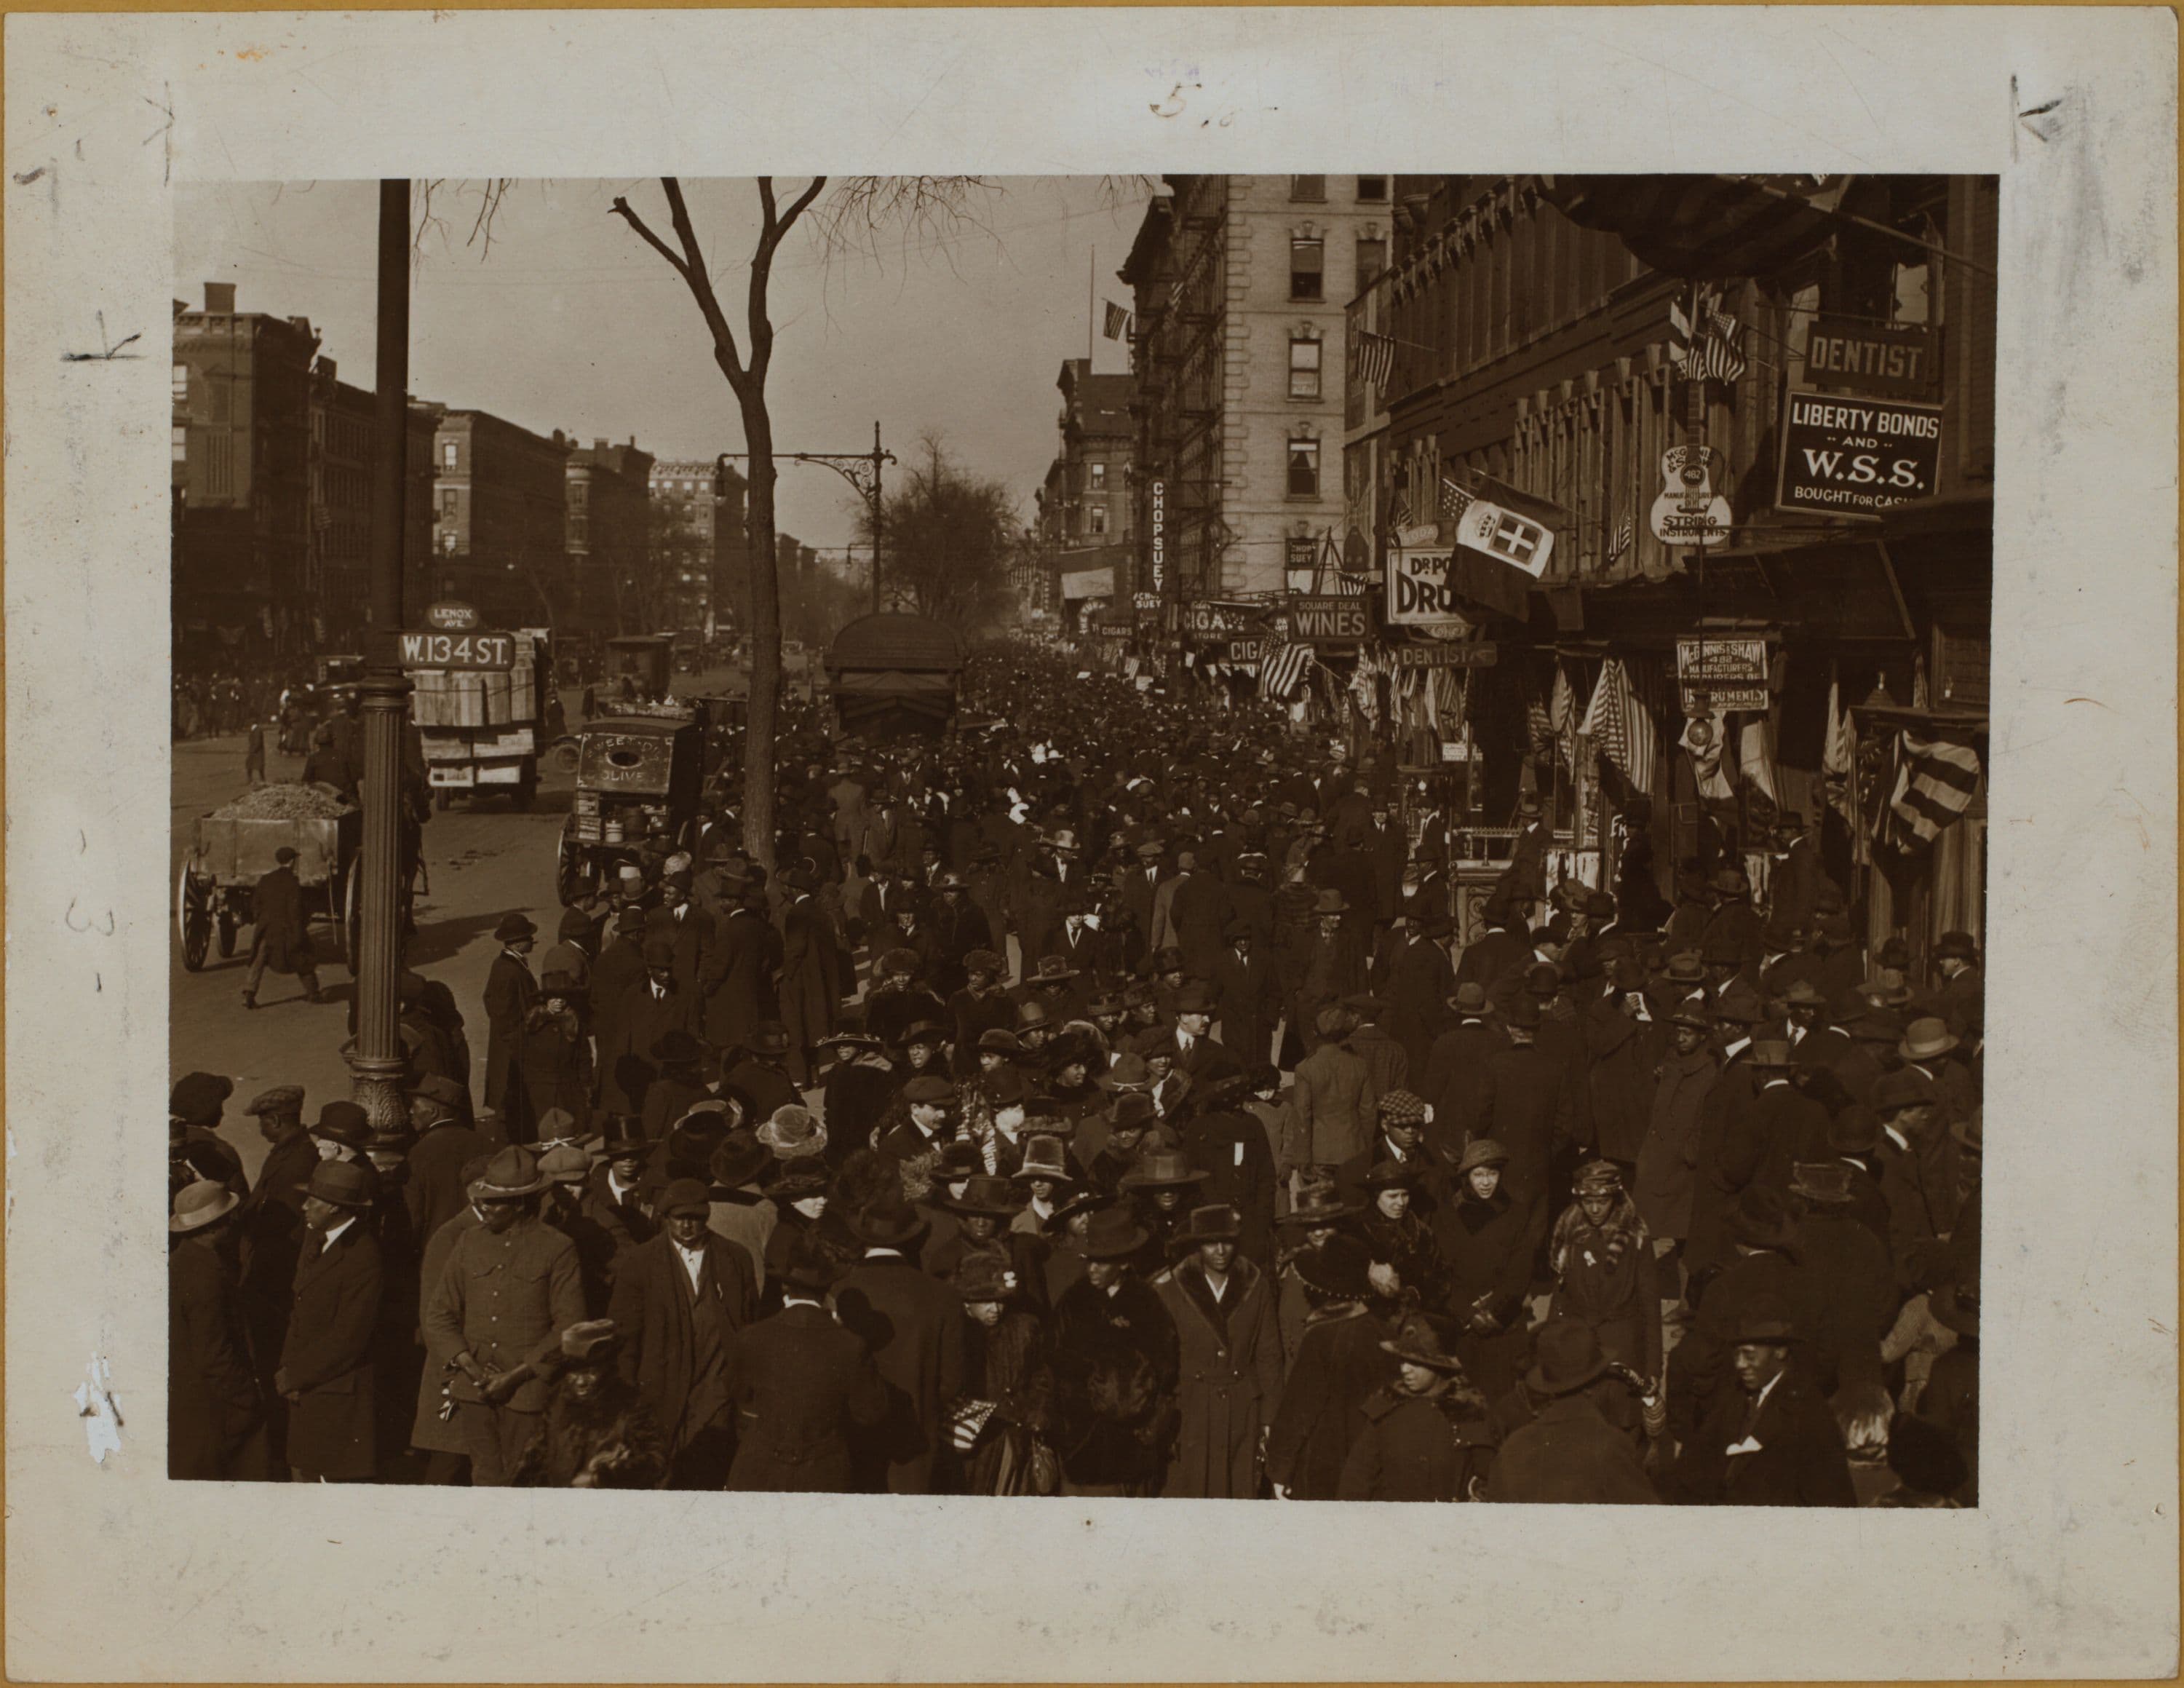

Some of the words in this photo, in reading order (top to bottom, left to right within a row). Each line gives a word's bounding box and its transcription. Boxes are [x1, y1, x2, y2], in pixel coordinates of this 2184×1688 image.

[1810, 336, 1923, 379] DENTIST
[1792, 402, 1875, 432] LIBERTY
[1875, 411, 1939, 439] BONDS
[1841, 436, 1878, 449] AND
[1683, 469, 1701, 480] 482
[1803, 448, 1925, 490] W.S.S.
[1794, 486, 1853, 504] BOUGHT
[1853, 494, 1873, 506] FOR
[1874, 495, 1914, 508] CAS
[1663, 515, 1718, 526] STRING
[1290, 553, 1312, 563] SUEY
[1135, 599, 1162, 609] SUEY
[1298, 601, 1335, 611] SQUARE
[1338, 601, 1362, 611] DEAL
[434, 609, 472, 619] LENOX
[1295, 611, 1366, 636] WINES
[1101, 627, 1133, 637] CIGARS
[1194, 633, 1223, 641] STORE
[476, 638, 508, 665] ST.
[1402, 649, 1469, 665] DENTIST
[1731, 643, 1761, 666] SHAW
[1709, 655, 1733, 663] 482
[1688, 663, 1753, 673] MANUFACTURERS
[1684, 687, 1764, 703] INRUMENTS
[602, 769, 647, 781] OLIVE
